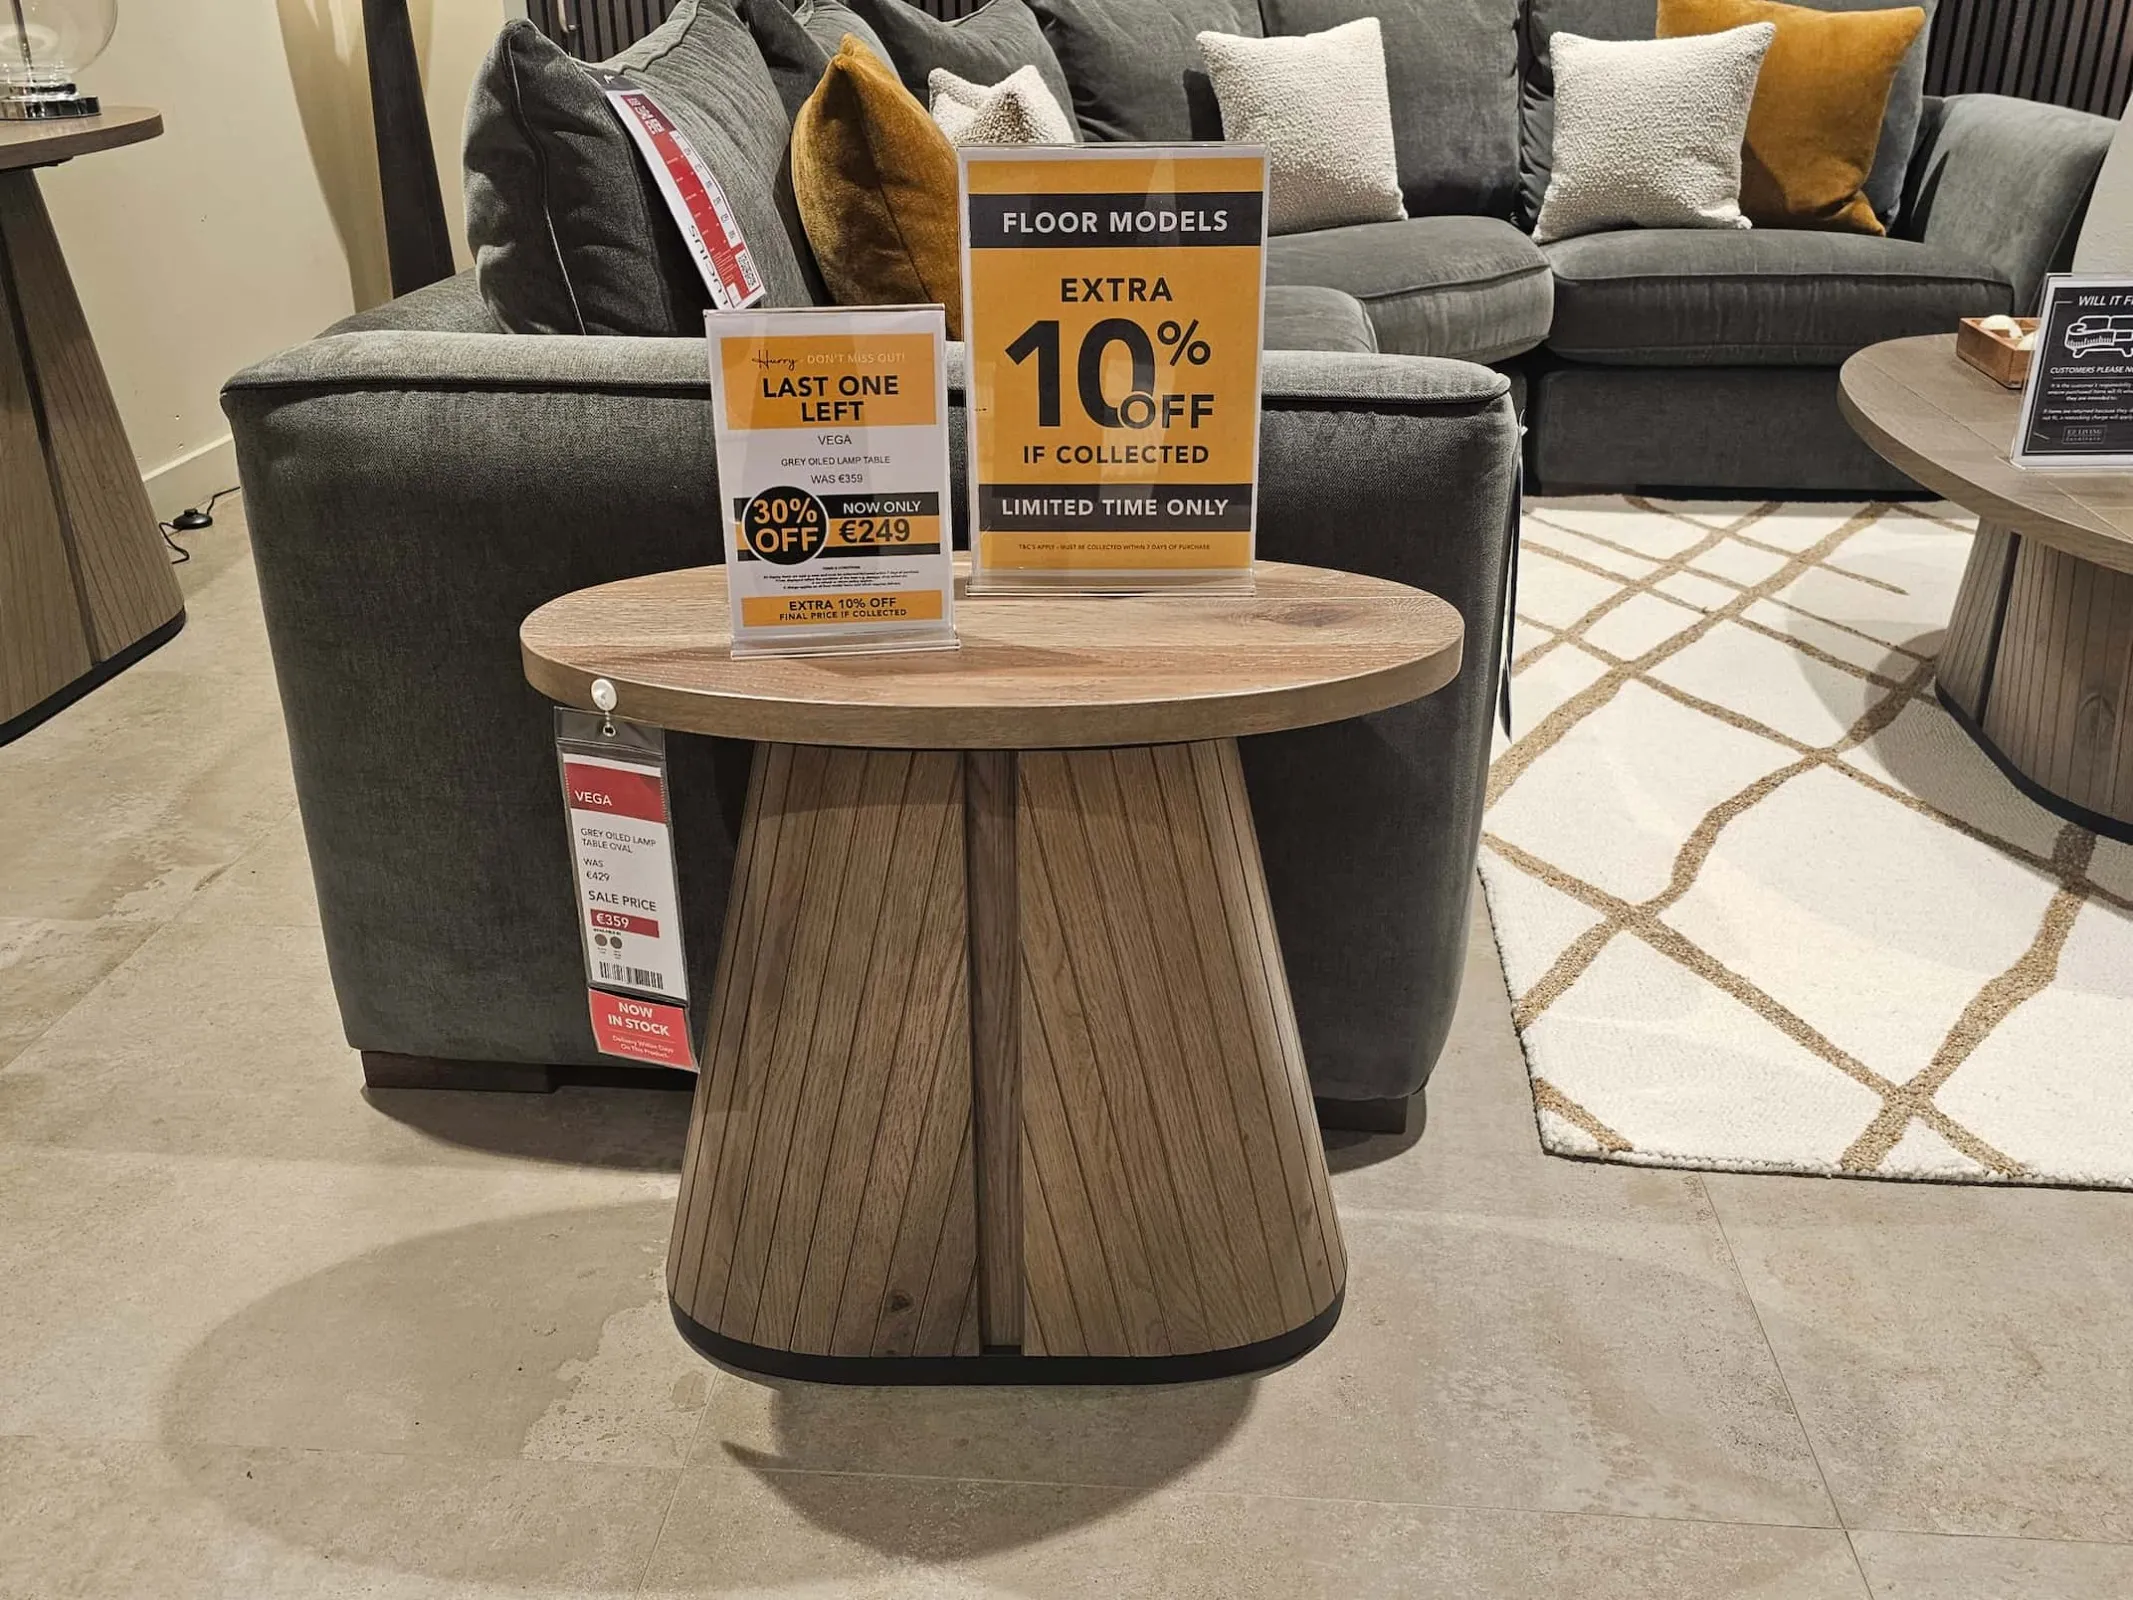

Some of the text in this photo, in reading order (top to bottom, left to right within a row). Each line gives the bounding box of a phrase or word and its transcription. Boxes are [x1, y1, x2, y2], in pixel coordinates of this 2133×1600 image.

[1002, 210, 1228, 233] FLOOR MODELS
[1060, 277, 1173, 302] EXTRA
[2079, 295, 2107, 306] WILL
[2109, 295, 2123, 306] IT
[751, 350, 798, 371] Hurry
[807, 353, 844, 364] DON'T
[847, 352, 874, 363] MISS
[877, 352, 905, 363] OUT!
[1004, 317, 1211, 428] 10%
[2050, 366, 2096, 374] CUSTOMERS
[763, 375, 899, 398] LAST ONE
[801, 401, 864, 422] LEFT
[1120, 394, 1215, 429] OFF
[817, 434, 852, 445] VEGA
[781, 455, 891, 467] GREY OILED LAMP TABLE
[1023, 445, 1209, 464] IF COLLECTED
[811, 473, 863, 484] WAS €359
[753, 497, 818, 524] 30%
[843, 500, 921, 514] NOW ONLY
[1002, 498, 1229, 516] LIMITED TIME ONLY
[838, 518, 911, 543] €249
[755, 527, 819, 553] OFF
[789, 597, 896, 611] EXTRA 10% OFF
[779, 609, 908, 621] FINAL PRICE IF COLLECTED
[574, 790, 612, 806] VEGA
[580, 828, 656, 847] GREY OILED LAMP
[582, 839, 633, 854] TABLE OVAL
[583, 858, 604, 868] WAS
[586, 870, 610, 882] €429
[588, 890, 657, 912] SALE PRICE
[596, 912, 630, 929] €359
[618, 1002, 653, 1019] NOW
[607, 1014, 670, 1036] IN STOCK
